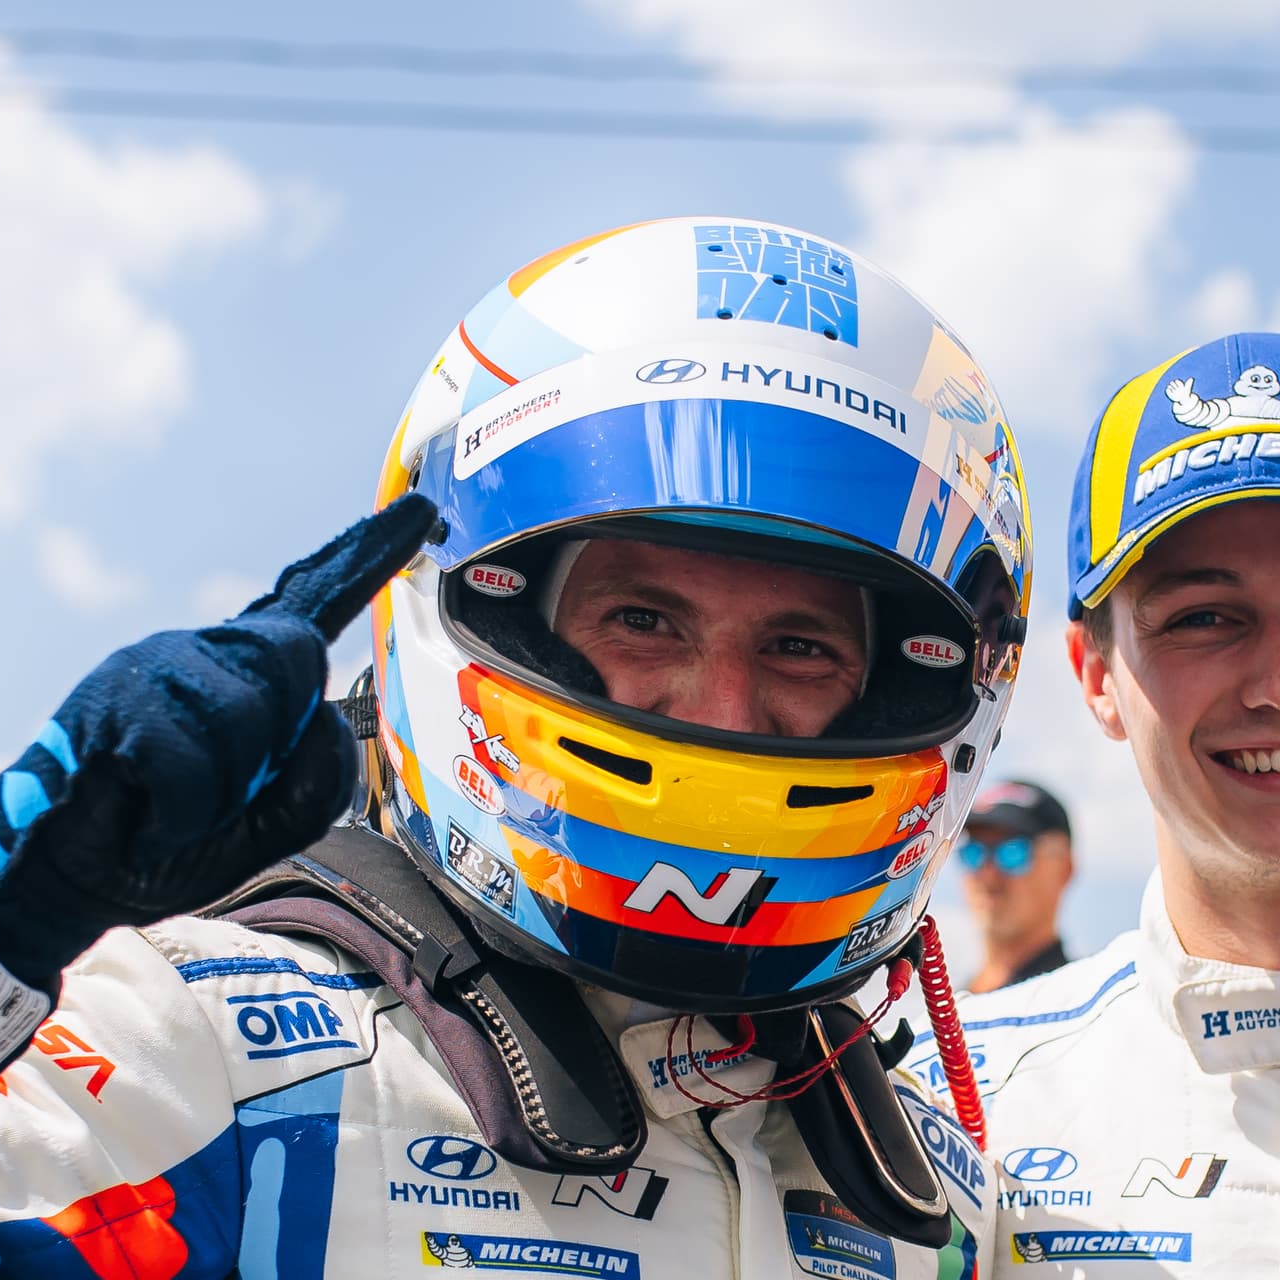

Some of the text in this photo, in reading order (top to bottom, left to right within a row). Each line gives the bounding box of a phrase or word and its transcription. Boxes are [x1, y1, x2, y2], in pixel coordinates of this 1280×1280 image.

[721, 362, 906, 434] HYUNDAI
[484, 396, 561, 440] AUTOSPORT
[472, 568, 517, 591] BELL
[909, 641, 955, 660] BELL
[458, 760, 497, 808] BELL
[893, 838, 927, 872] BELL
[237, 1002, 343, 1046] OMP
[921, 1116, 986, 1190] OMP
[390, 1182, 520, 1211] HYUNDAI
[997, 1190, 1091, 1209] HYUNDAI
[479, 1242, 629, 1274] MICHELIN
[827, 1235, 883, 1261] MICHELIN
[1050, 1236, 1183, 1253] MICHELIN
[812, 1260, 839, 1275] PILOT
